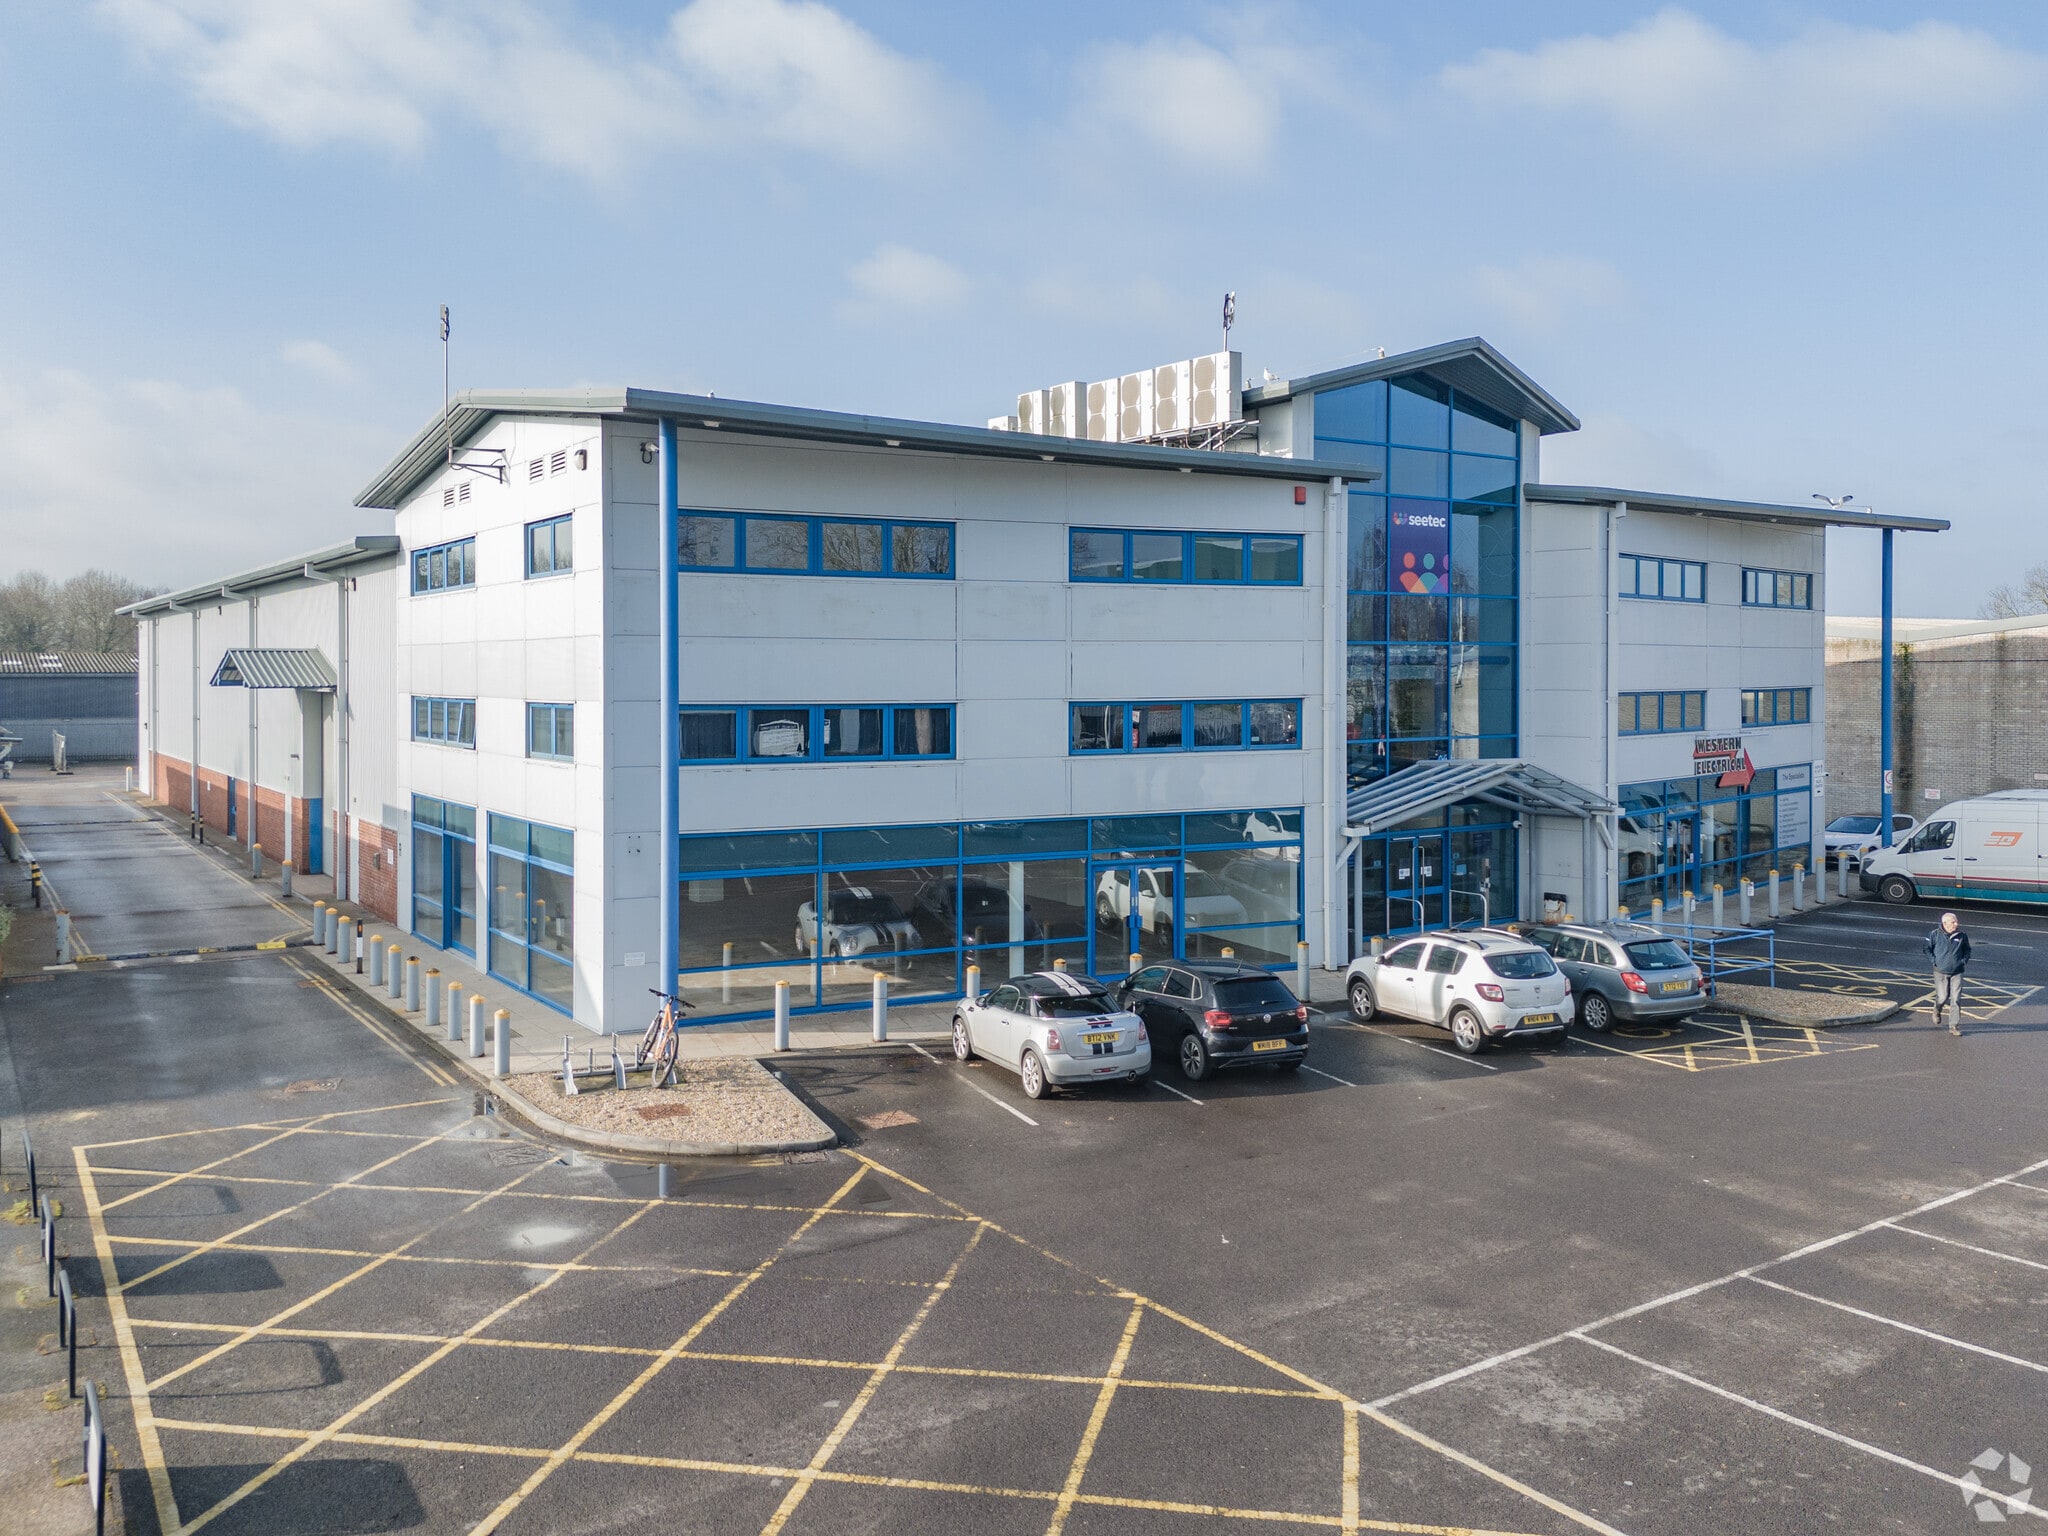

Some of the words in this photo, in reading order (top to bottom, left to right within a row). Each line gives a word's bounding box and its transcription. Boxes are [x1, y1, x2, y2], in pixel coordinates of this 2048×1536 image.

[1408, 514, 1446, 528] seetec
[1695, 736, 1742, 753] WESTERN
[1695, 757, 1746, 775] ELECTRICAL
